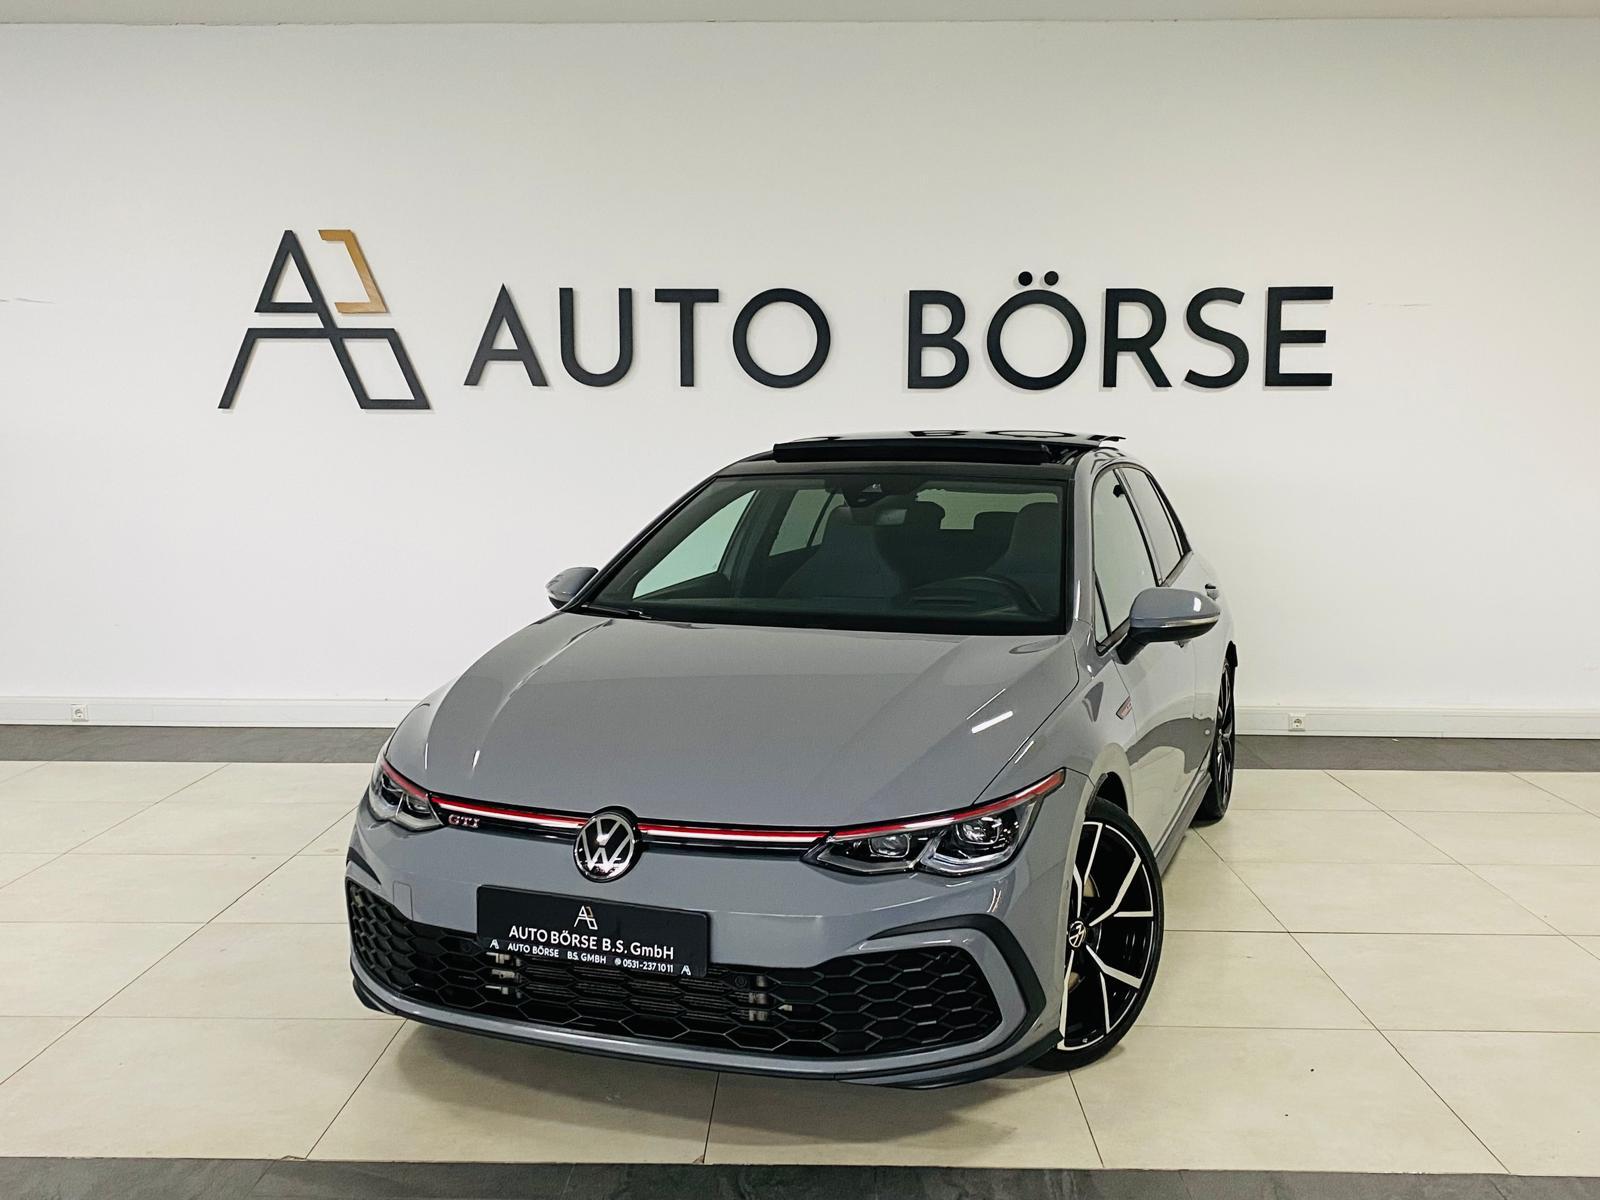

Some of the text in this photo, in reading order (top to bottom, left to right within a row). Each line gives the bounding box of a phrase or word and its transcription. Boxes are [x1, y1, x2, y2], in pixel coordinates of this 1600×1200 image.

[464, 270, 1334, 391] AUTO BÖRSE
[448, 814, 480, 829] GTI
[507, 942, 530, 953] AUTO
[532, 945, 559, 958] BÖRSE
[580, 952, 607, 964] GMBH
[509, 925, 674, 960] AUTO BÖRSE B.S. GmbH
